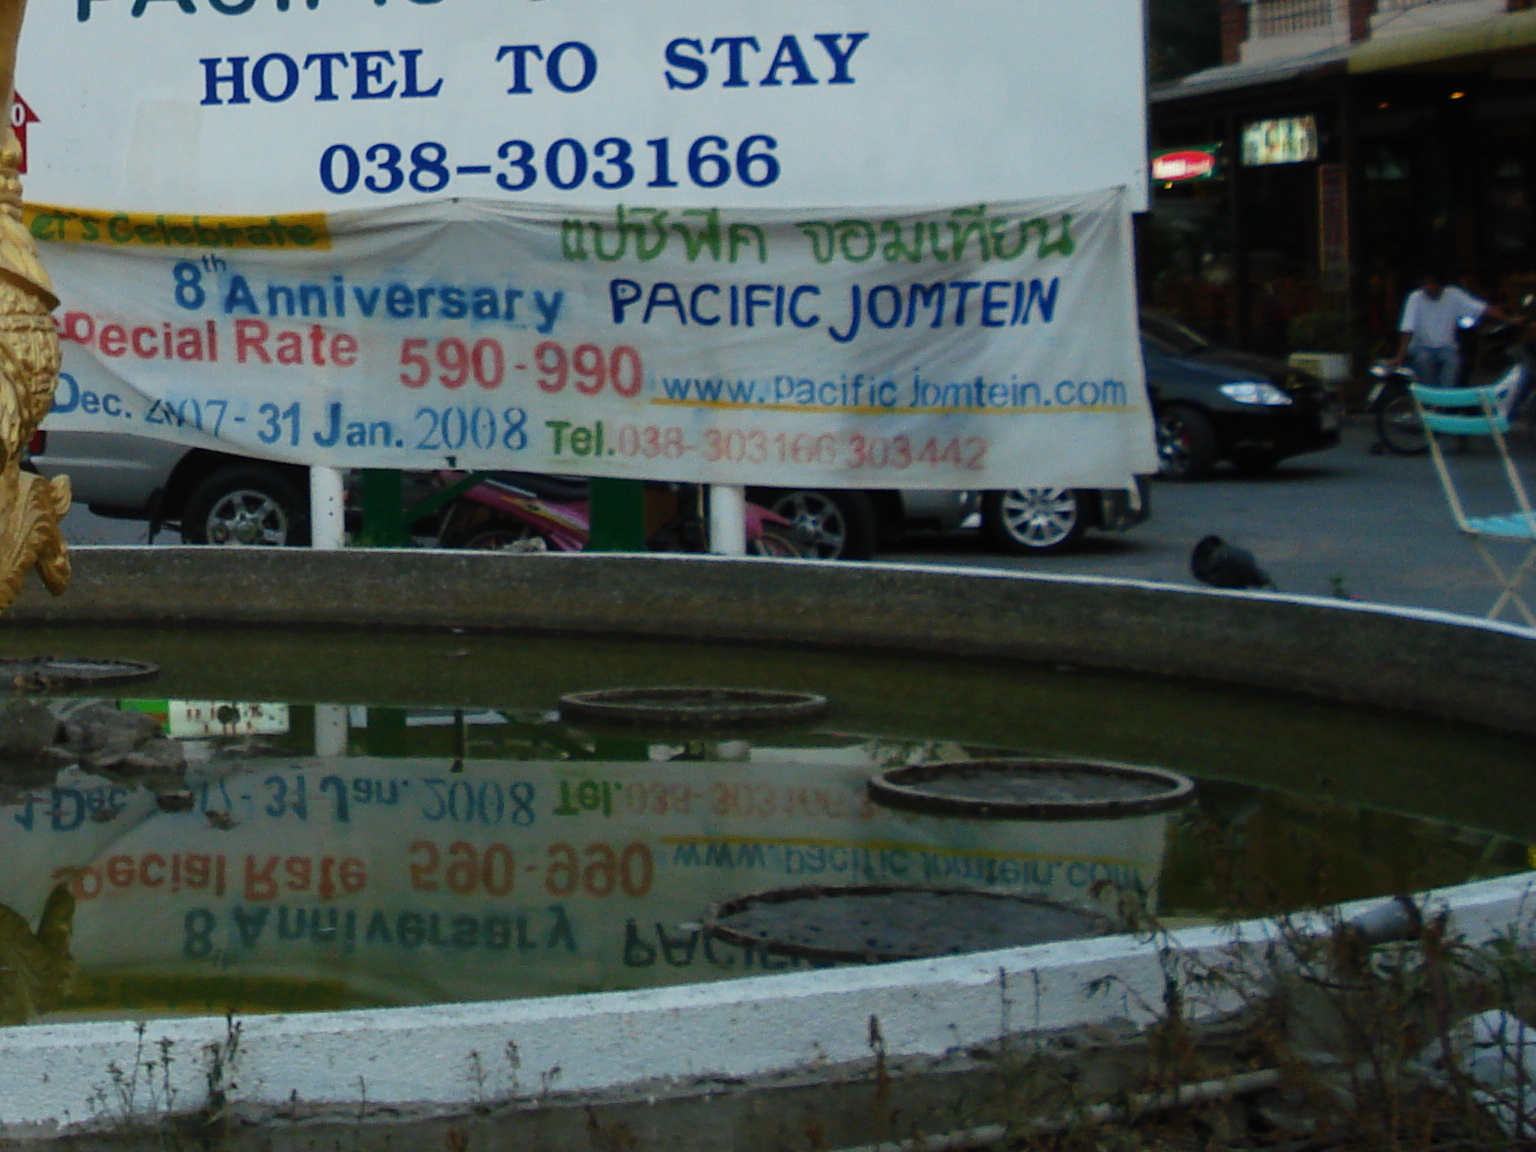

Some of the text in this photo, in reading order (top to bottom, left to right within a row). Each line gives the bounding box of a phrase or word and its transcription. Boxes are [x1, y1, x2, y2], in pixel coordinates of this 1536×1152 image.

[198, 32, 870, 106] HOTEL TO STAY
[319, 134, 782, 195] 038-303166
[107, 214, 318, 247] Celebrate
[224, 275, 565, 334] Anniversary
[609, 276, 1061, 343] PACIFIC JOMTEIN
[235, 318, 359, 369] Rate
[398, 336, 644, 398] 590-990
[51, 372, 133, 420] Dec.
[313, 401, 404, 449] Jan.
[415, 405, 529, 452] 2008
[545, 418, 616, 460] Tel.
